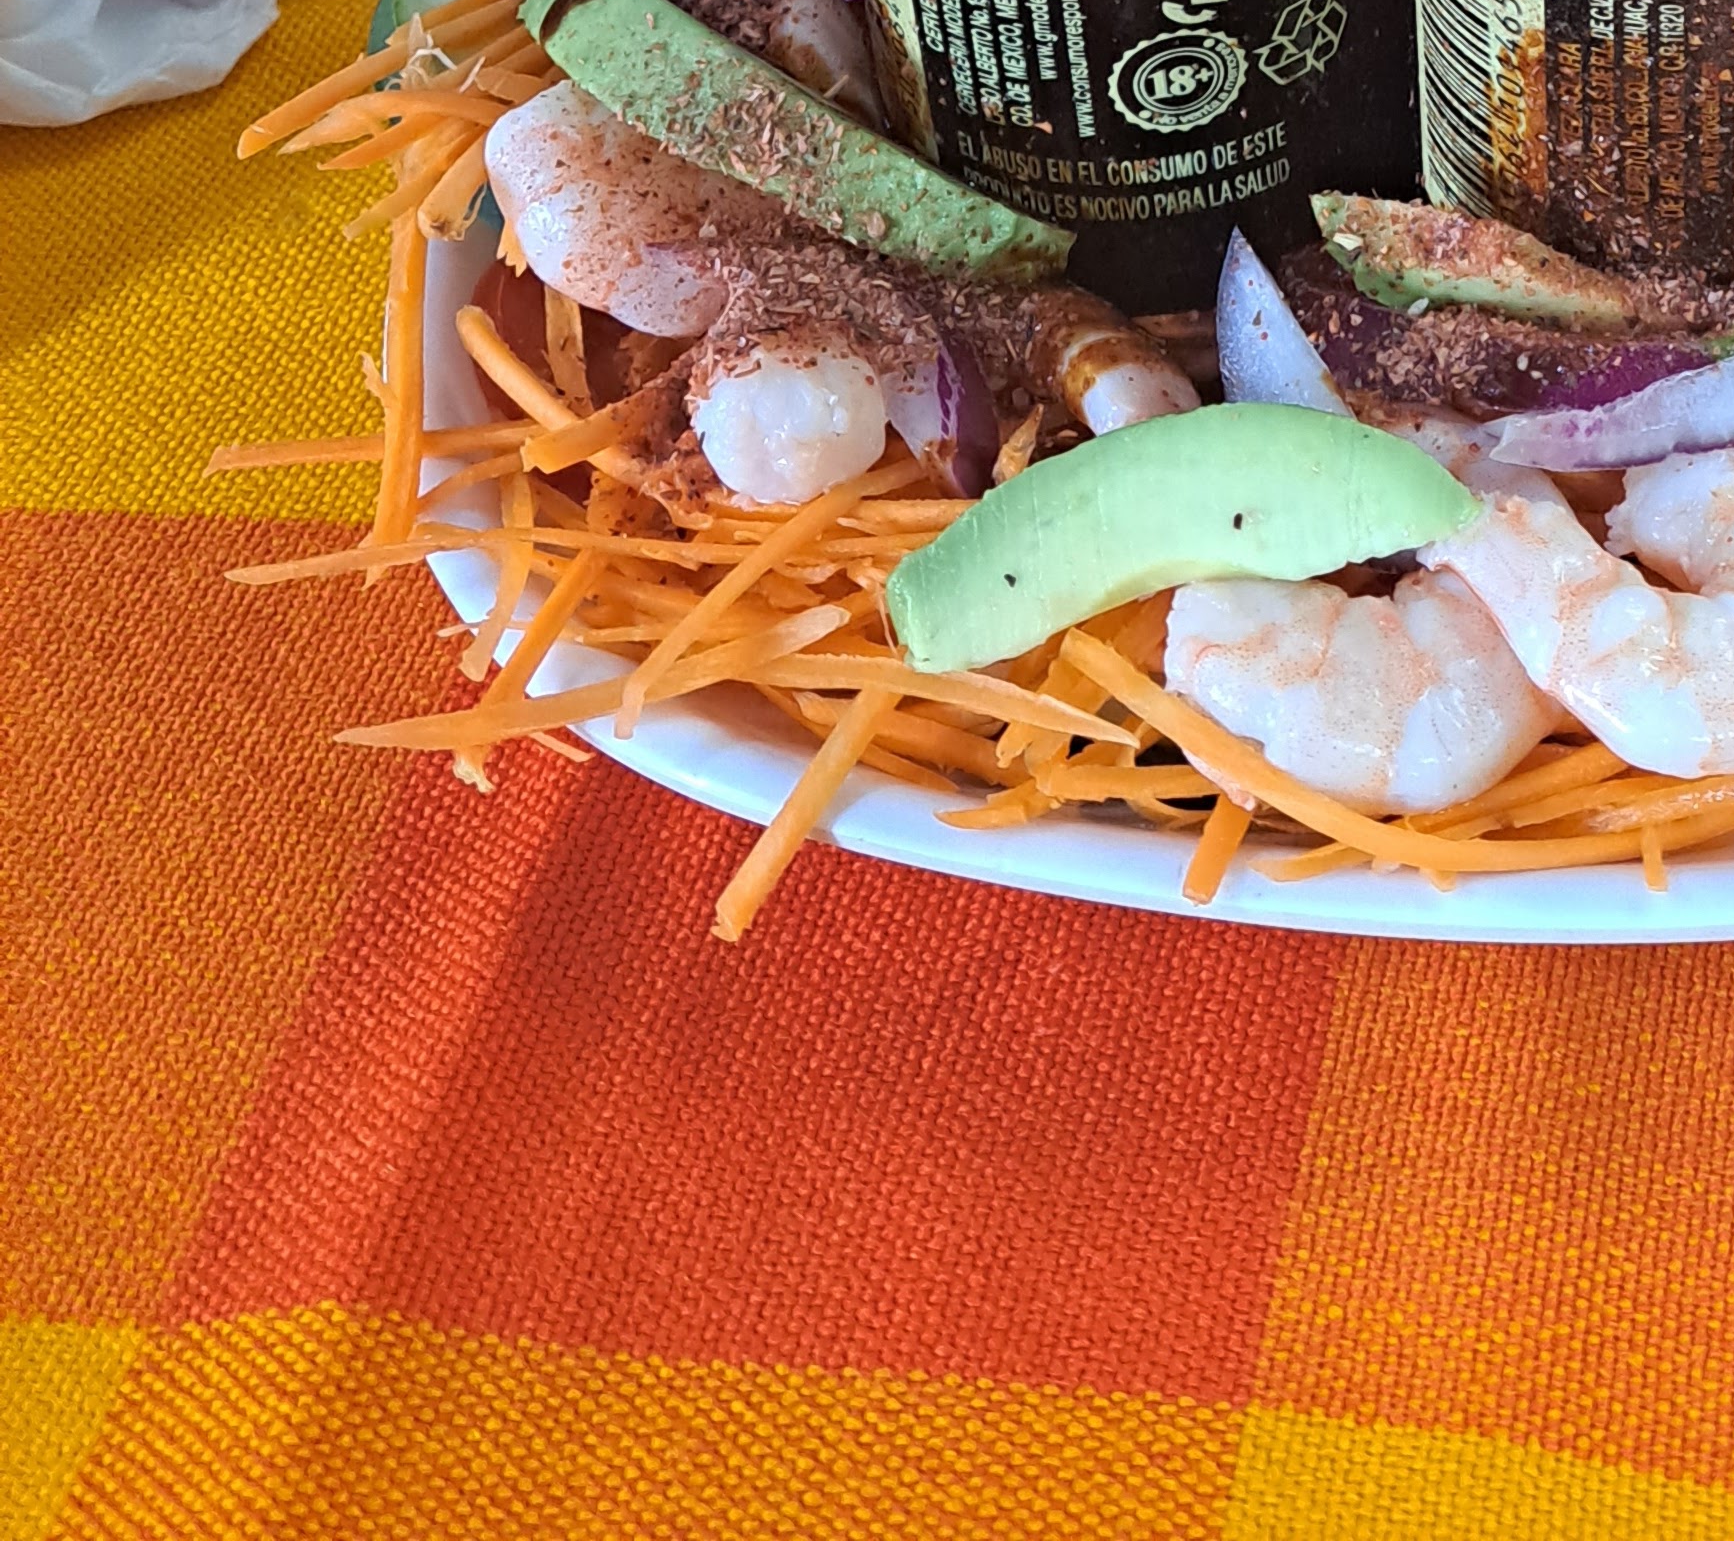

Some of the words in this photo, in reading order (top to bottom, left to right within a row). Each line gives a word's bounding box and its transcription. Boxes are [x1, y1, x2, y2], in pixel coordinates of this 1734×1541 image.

[971, 28, 1000, 92] ALBERTO
[1005, 81, 1032, 103] DE
[957, 130, 979, 162] EL
[981, 143, 1041, 181] ABUSO
[1046, 158, 1073, 184] EN
[1077, 161, 1102, 186] EL
[1107, 150, 1208, 186] CONSUMO
[1212, 140, 1238, 170] DE
[1243, 121, 1288, 160] ESTE
[1054, 193, 1077, 219] ES
[1079, 195, 1149, 221] NOCIVO
[1153, 186, 1206, 218] PARA
[1208, 179, 1233, 208] LA
[1234, 157, 1291, 200] SALUD
